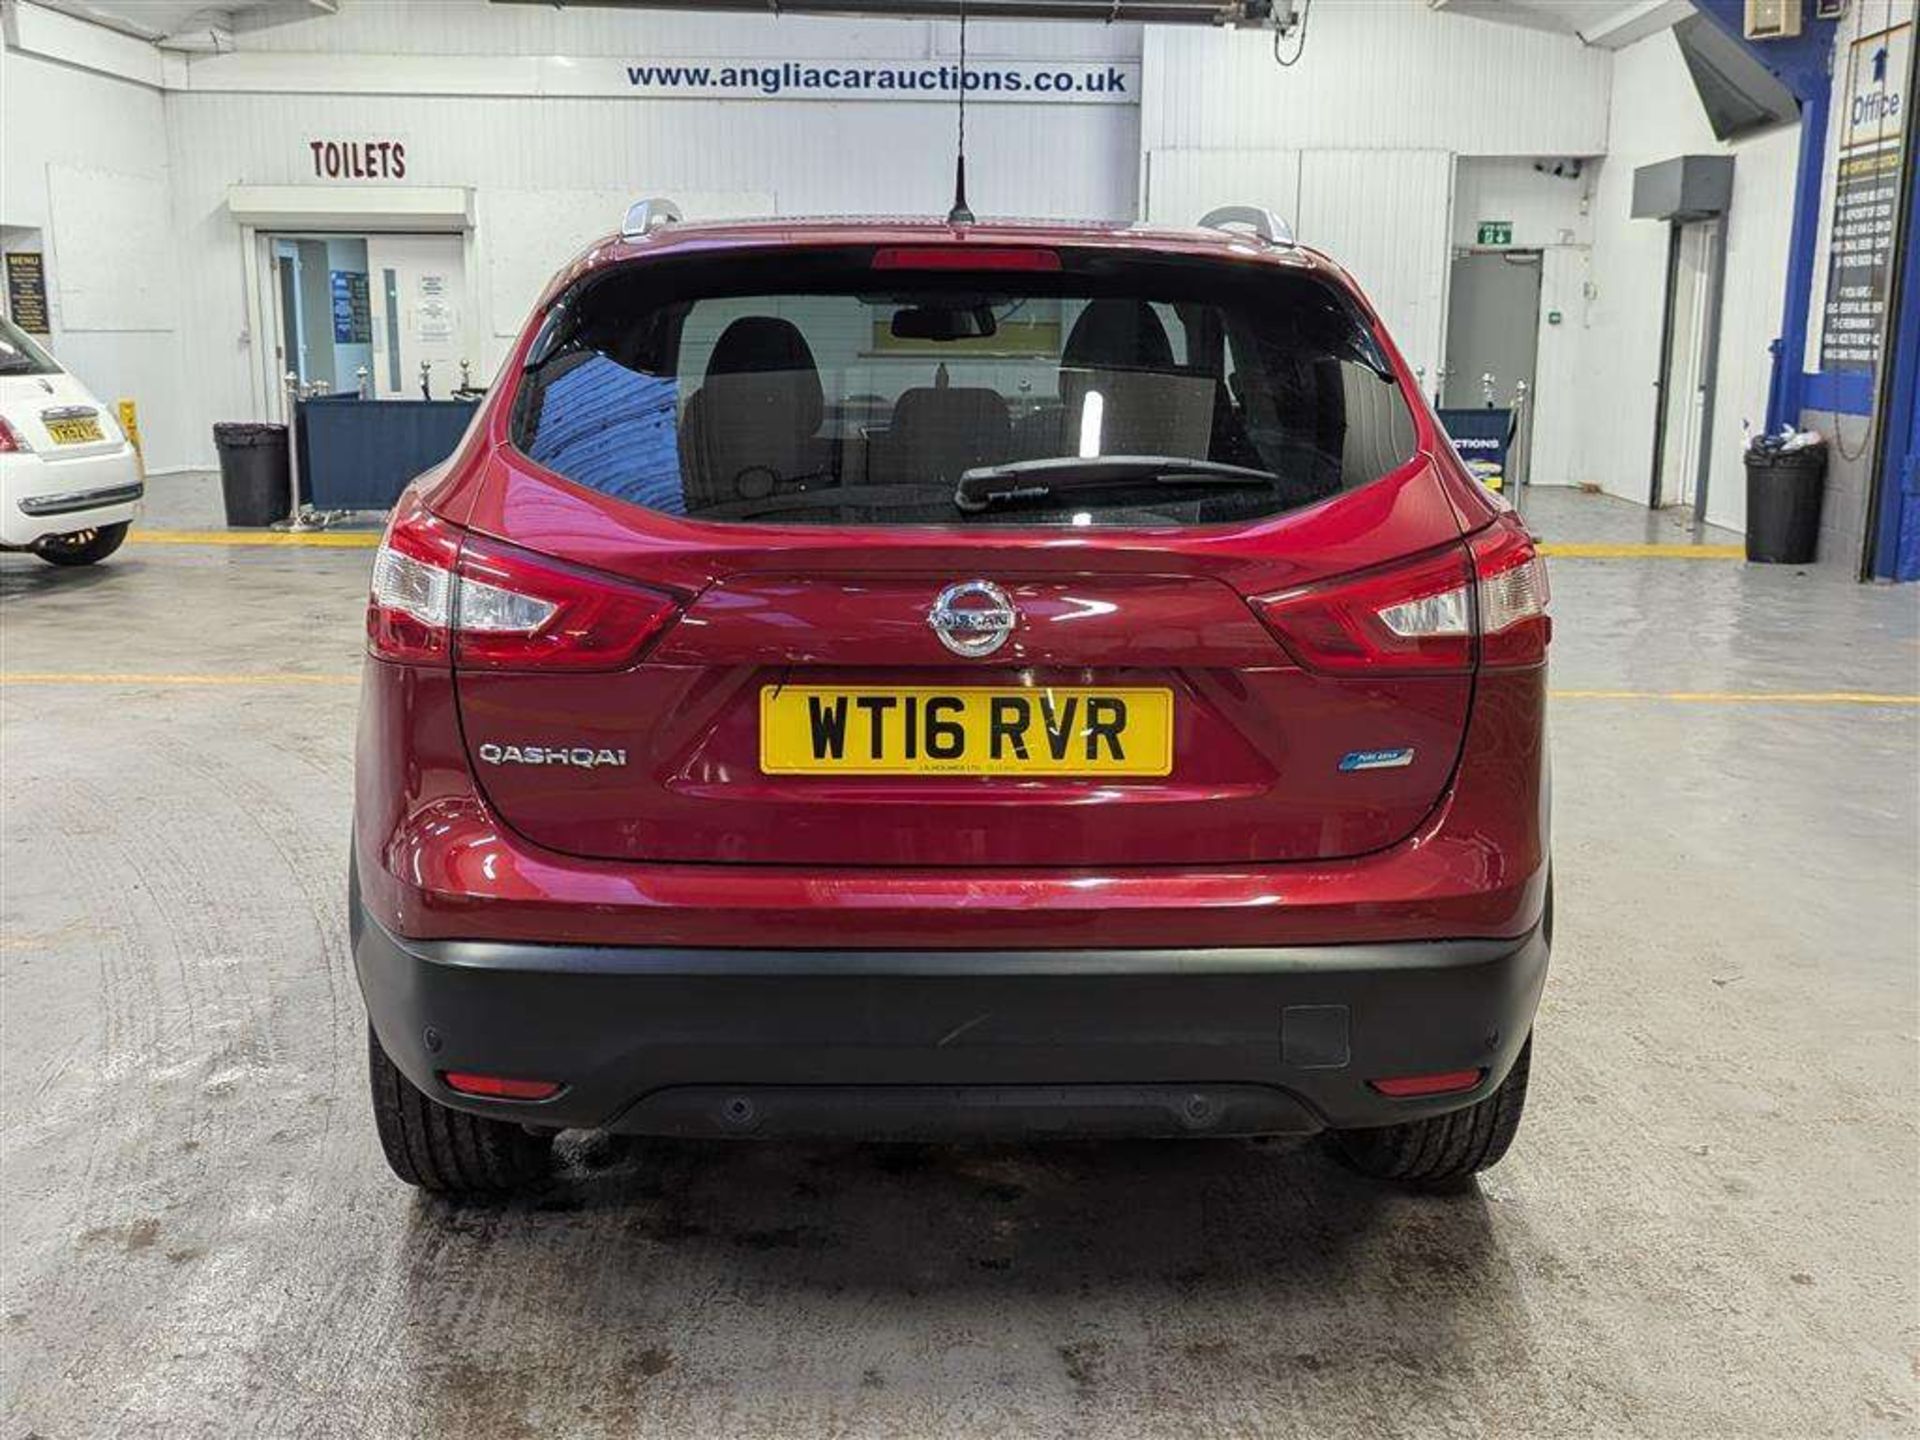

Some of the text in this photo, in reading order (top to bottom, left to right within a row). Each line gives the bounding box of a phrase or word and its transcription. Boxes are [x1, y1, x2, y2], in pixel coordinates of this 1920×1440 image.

[627, 62, 1126, 94] www.angliacarauctions.co.uk
[1852, 93, 1900, 125] Office
[310, 141, 405, 178] TOILETS
[809, 696, 1127, 760] WT16 RVR
[479, 743, 627, 768] QASHQAI
